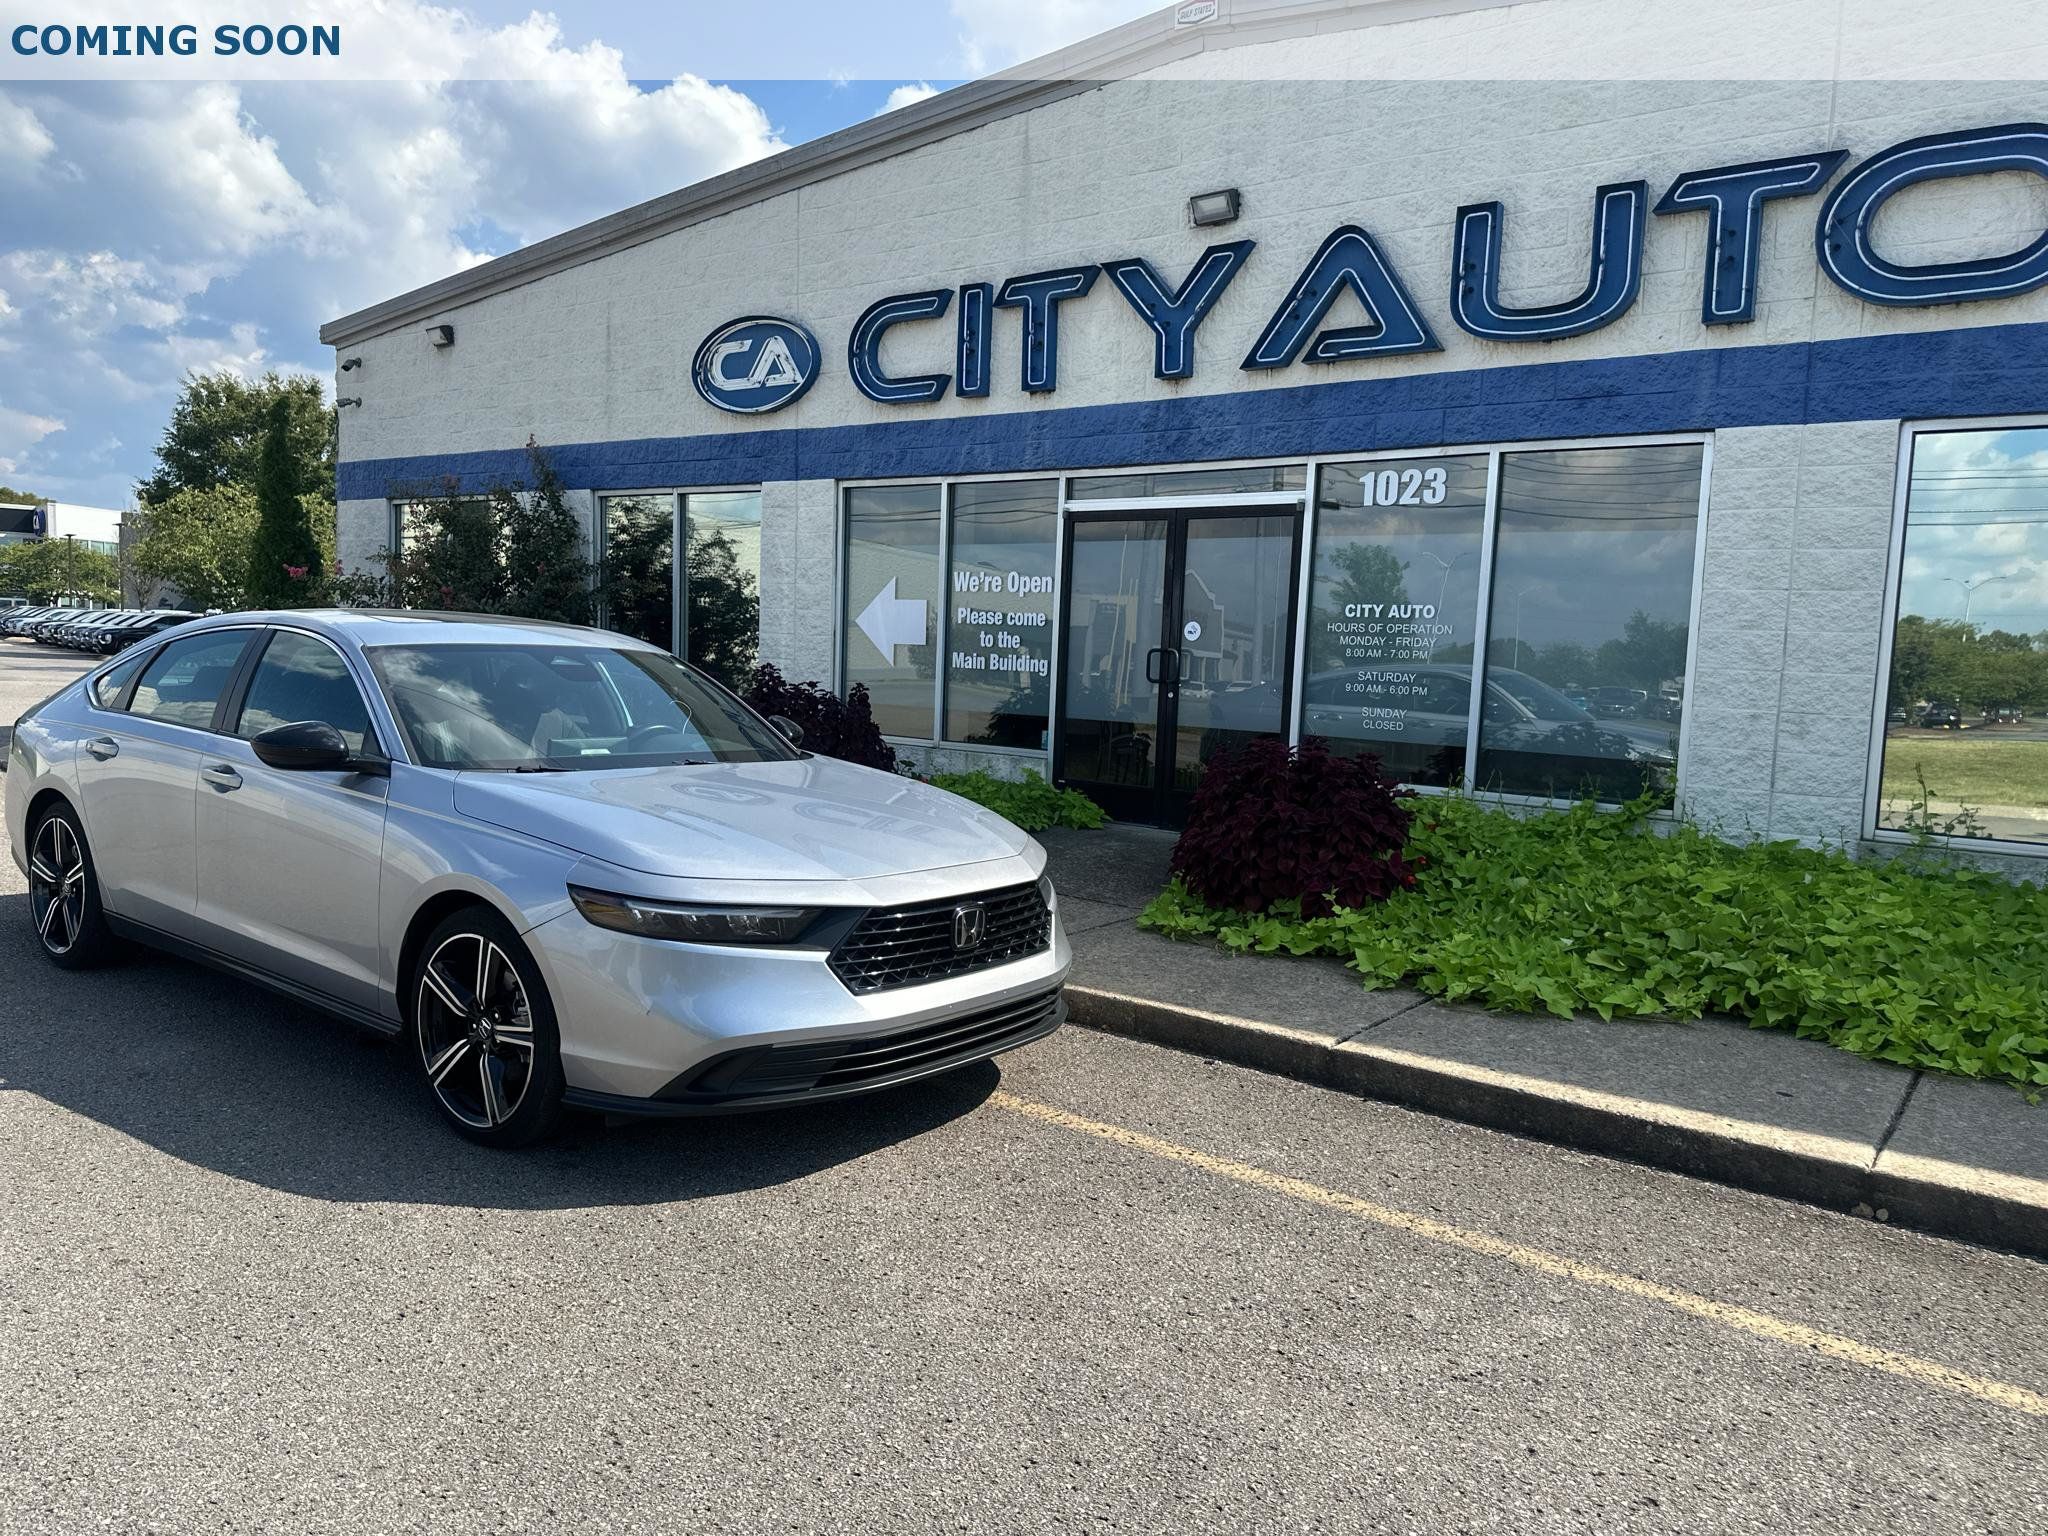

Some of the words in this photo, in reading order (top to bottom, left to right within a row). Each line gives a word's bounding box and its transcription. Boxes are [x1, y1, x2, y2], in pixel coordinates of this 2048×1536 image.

[848, 239, 1256, 404] CITY
[1239, 122, 2048, 371] AUTO
[708, 335, 805, 391] CA
[1360, 467, 1447, 506] 1023
[954, 572, 1002, 592] We're
[1008, 571, 1052, 597] Open
[958, 608, 1002, 625] Please
[1007, 612, 1045, 626] come
[1345, 604, 1384, 618] CITY
[1388, 604, 1435, 618] AUTO
[1328, 623, 1365, 632] HOURS
[1369, 624, 1383, 633] OF
[1387, 624, 1452, 634] OPERATION
[980, 631, 993, 647] to
[998, 631, 1020, 648] the
[1340, 636, 1386, 646] MONDAY
[1396, 637, 1436, 647] FRIDAY
[1346, 648, 1364, 657] 8:00
[1367, 650, 1381, 658] AM
[1390, 650, 1409, 658] 7:00
[1413, 651, 1428, 659] PM
[952, 652, 985, 669] Main
[990, 654, 1048, 676] Building
[1358, 671, 1416, 683] SATURDAY
[1346, 684, 1364, 692] 9:00
[1366, 684, 1380, 692] AM
[1390, 686, 1409, 694] 6:00
[1412, 687, 1427, 695] PM
[1362, 707, 1407, 719] SUNDAY
[1363, 720, 1403, 730] CLOSED
